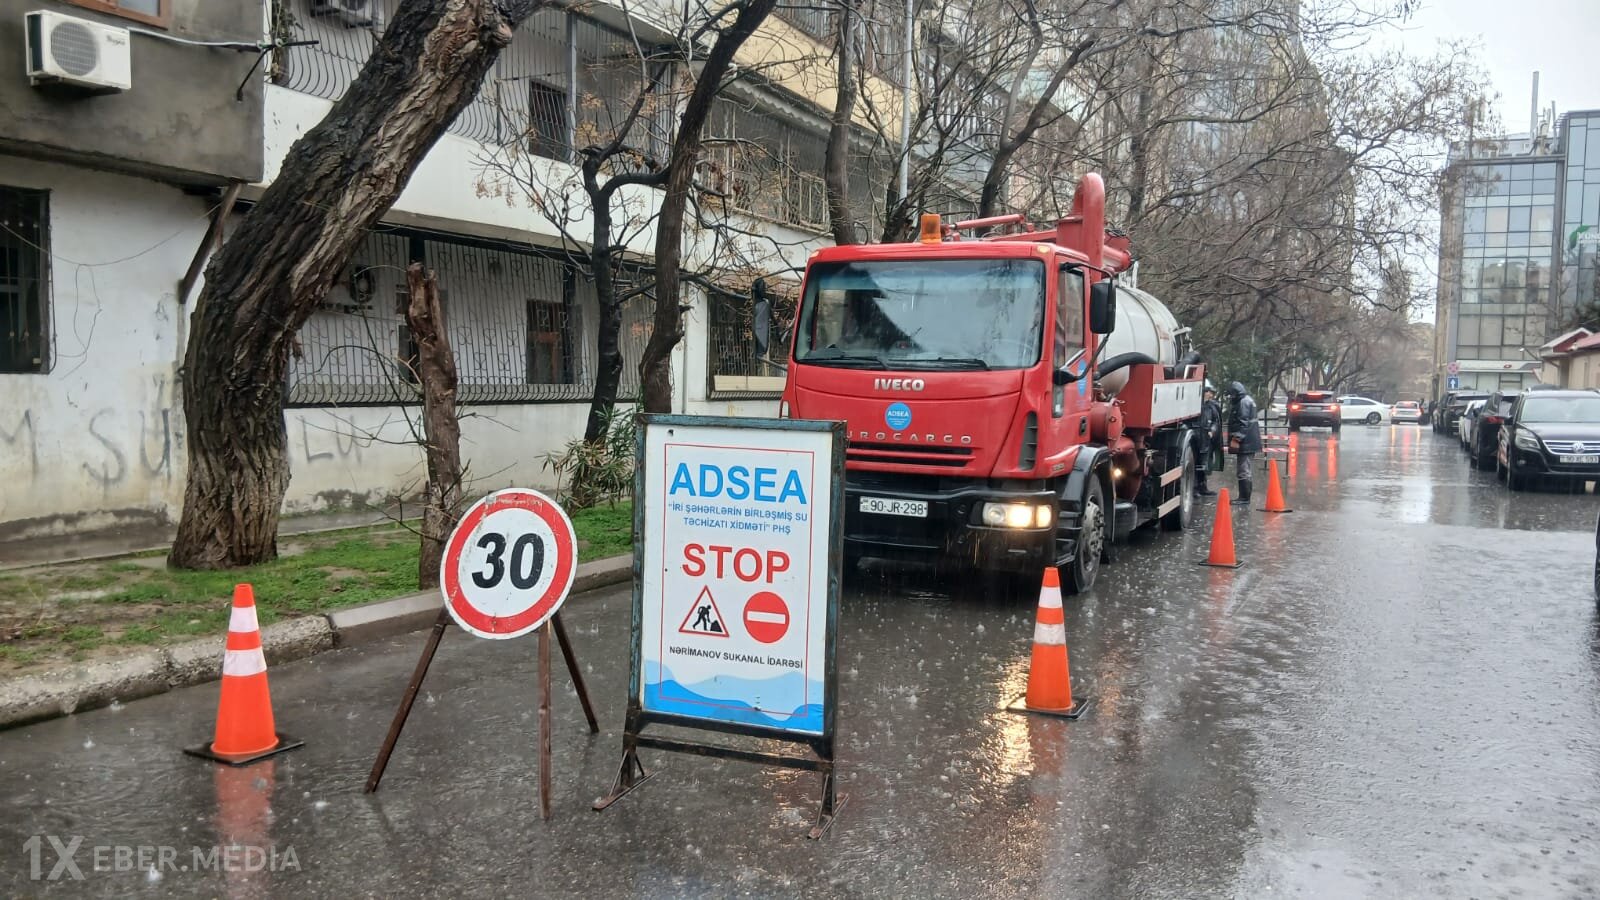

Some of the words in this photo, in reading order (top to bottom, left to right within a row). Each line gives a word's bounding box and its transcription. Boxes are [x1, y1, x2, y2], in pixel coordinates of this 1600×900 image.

[874, 378, 925, 391] IVECO
[847, 431, 972, 444] UROCARGO
[669, 462, 807, 504] ADSEA
[744, 507, 793, 522] BİRLƏŞMİŞ
[795, 512, 808, 521] SU
[772, 524, 791, 535] PHŞ
[471, 532, 545, 590] 30
[682, 543, 790, 584] STOP
[669, 645, 721, 660] NƏRİMANOV
[723, 652, 765, 665] SUKANAL
[766, 655, 803, 669] İDARƏSİ
